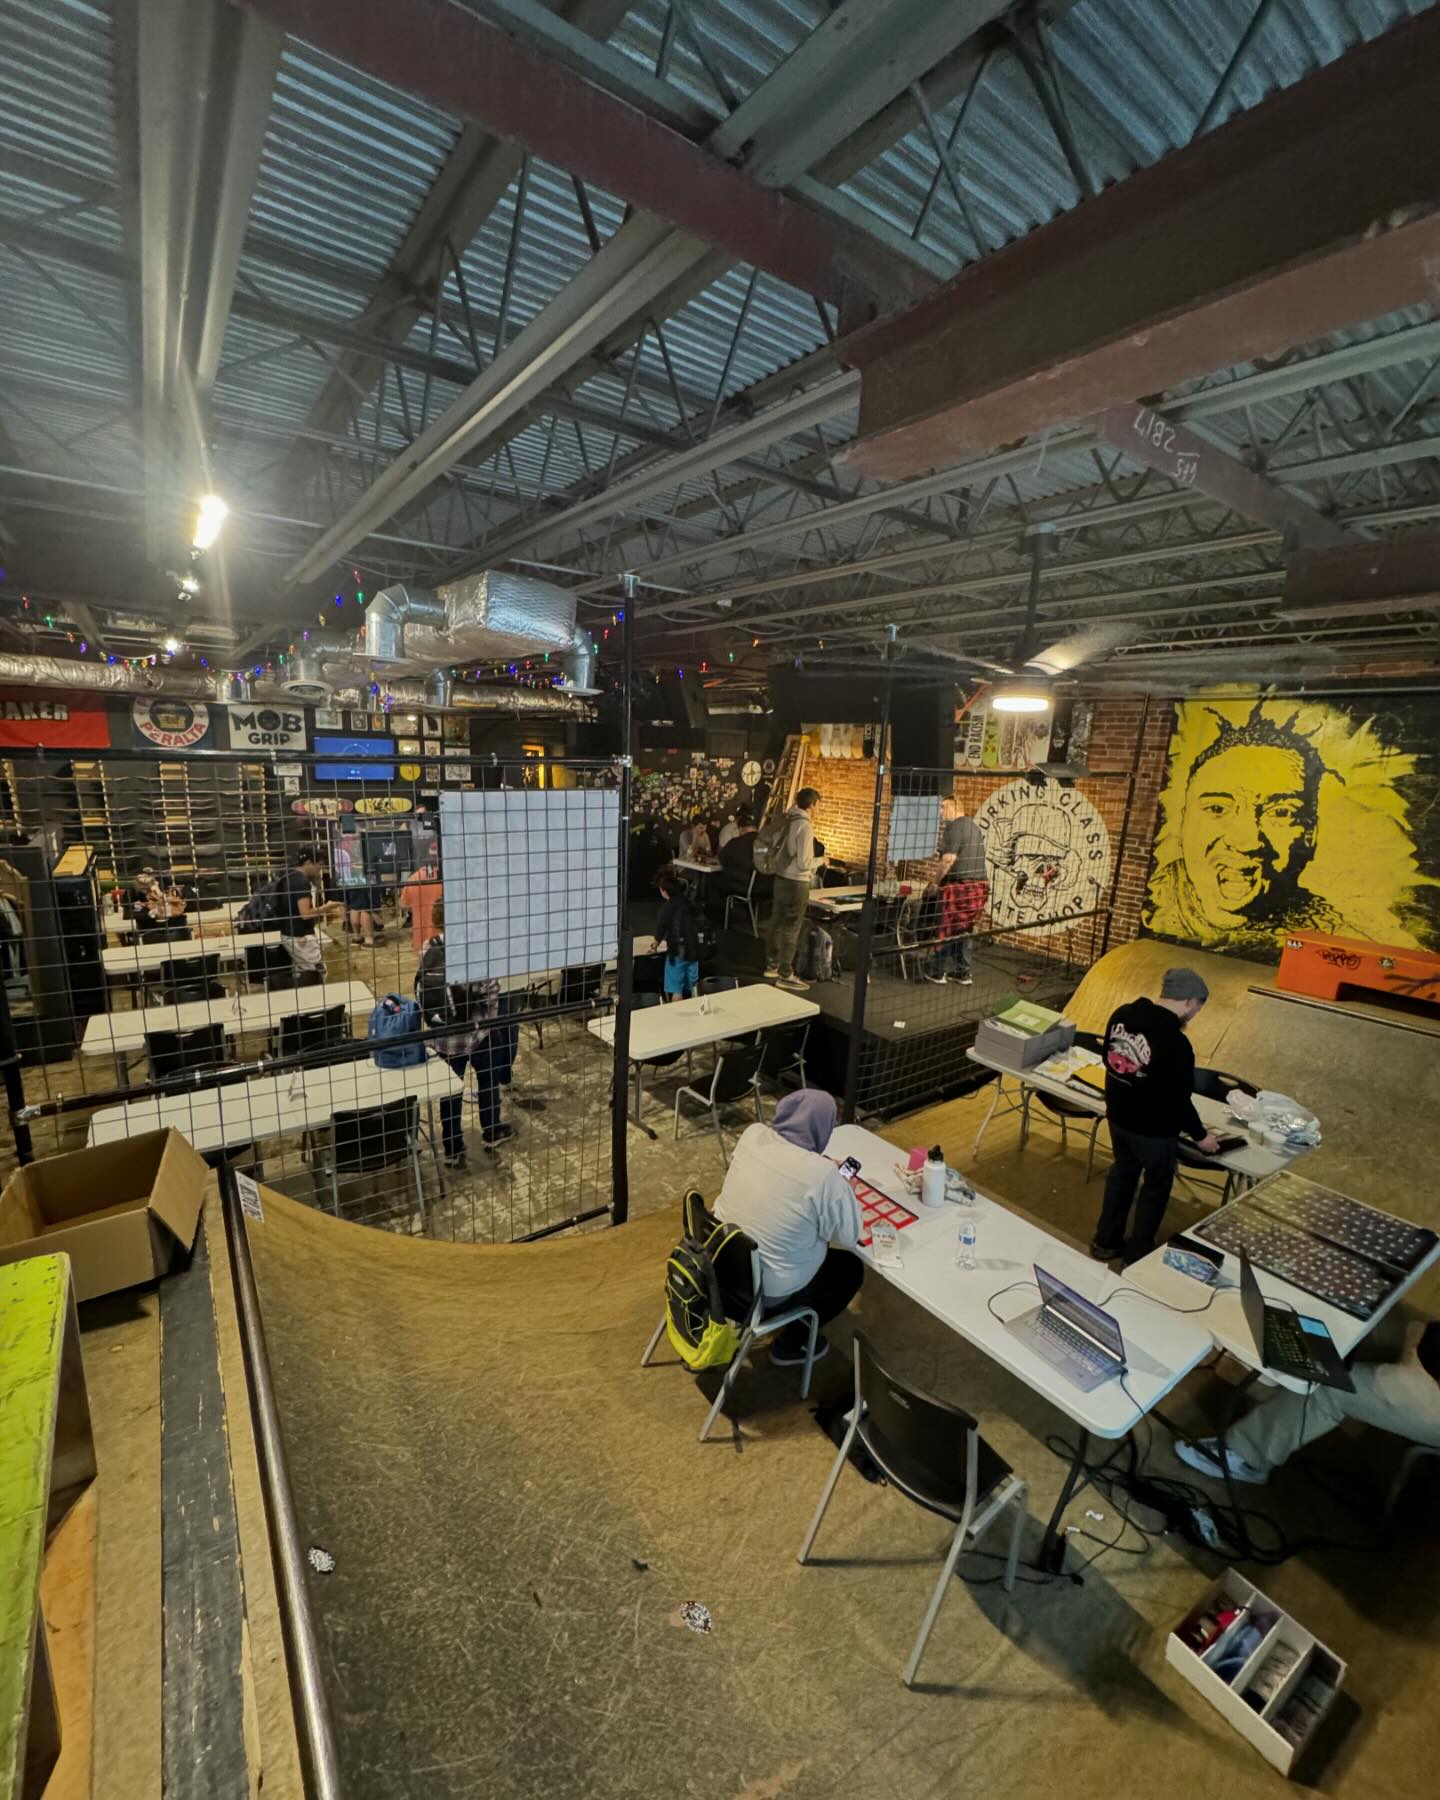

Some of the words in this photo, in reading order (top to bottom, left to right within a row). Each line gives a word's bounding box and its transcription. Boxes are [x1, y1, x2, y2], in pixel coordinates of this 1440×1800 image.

[0, 701, 68, 721] AKER
[231, 709, 302, 732] MOB
[248, 732, 290, 745] GRIP
[970, 714, 985, 743] RACISM
[968, 744, 981, 759] END
[978, 785, 1047, 838] URKING
[1059, 793, 1104, 861] CLASS
[991, 900, 1025, 924] ATE
